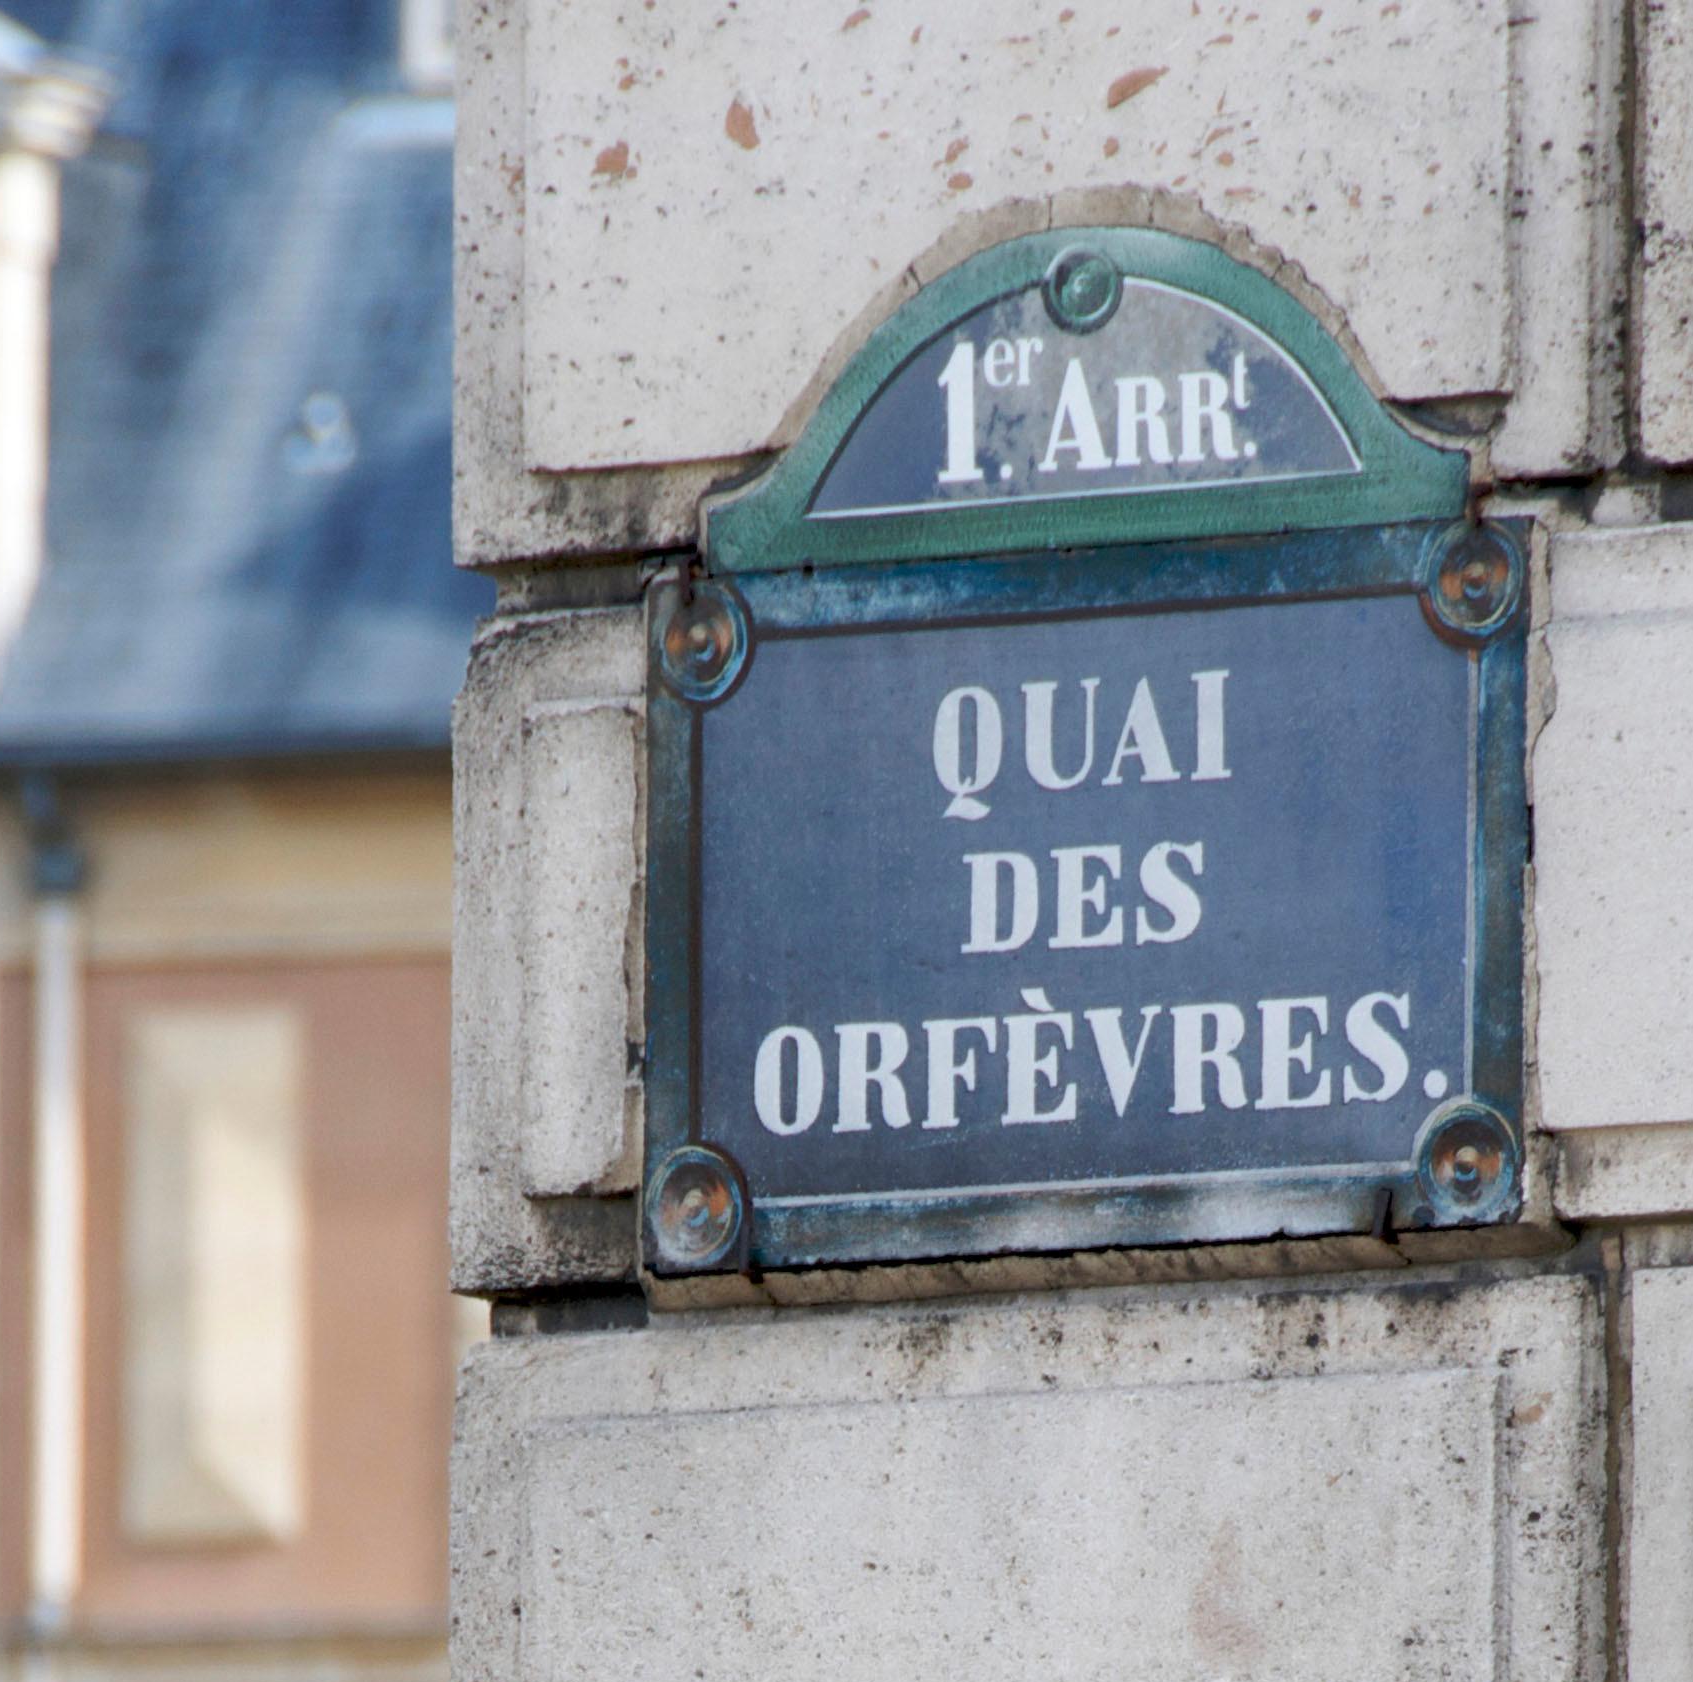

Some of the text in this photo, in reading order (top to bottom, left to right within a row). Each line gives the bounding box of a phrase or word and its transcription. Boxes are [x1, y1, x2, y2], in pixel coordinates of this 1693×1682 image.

[932, 670, 1231, 819] QUAI
[961, 842, 1204, 954] DES
[753, 989, 1449, 1137] ORFÈVRES.
